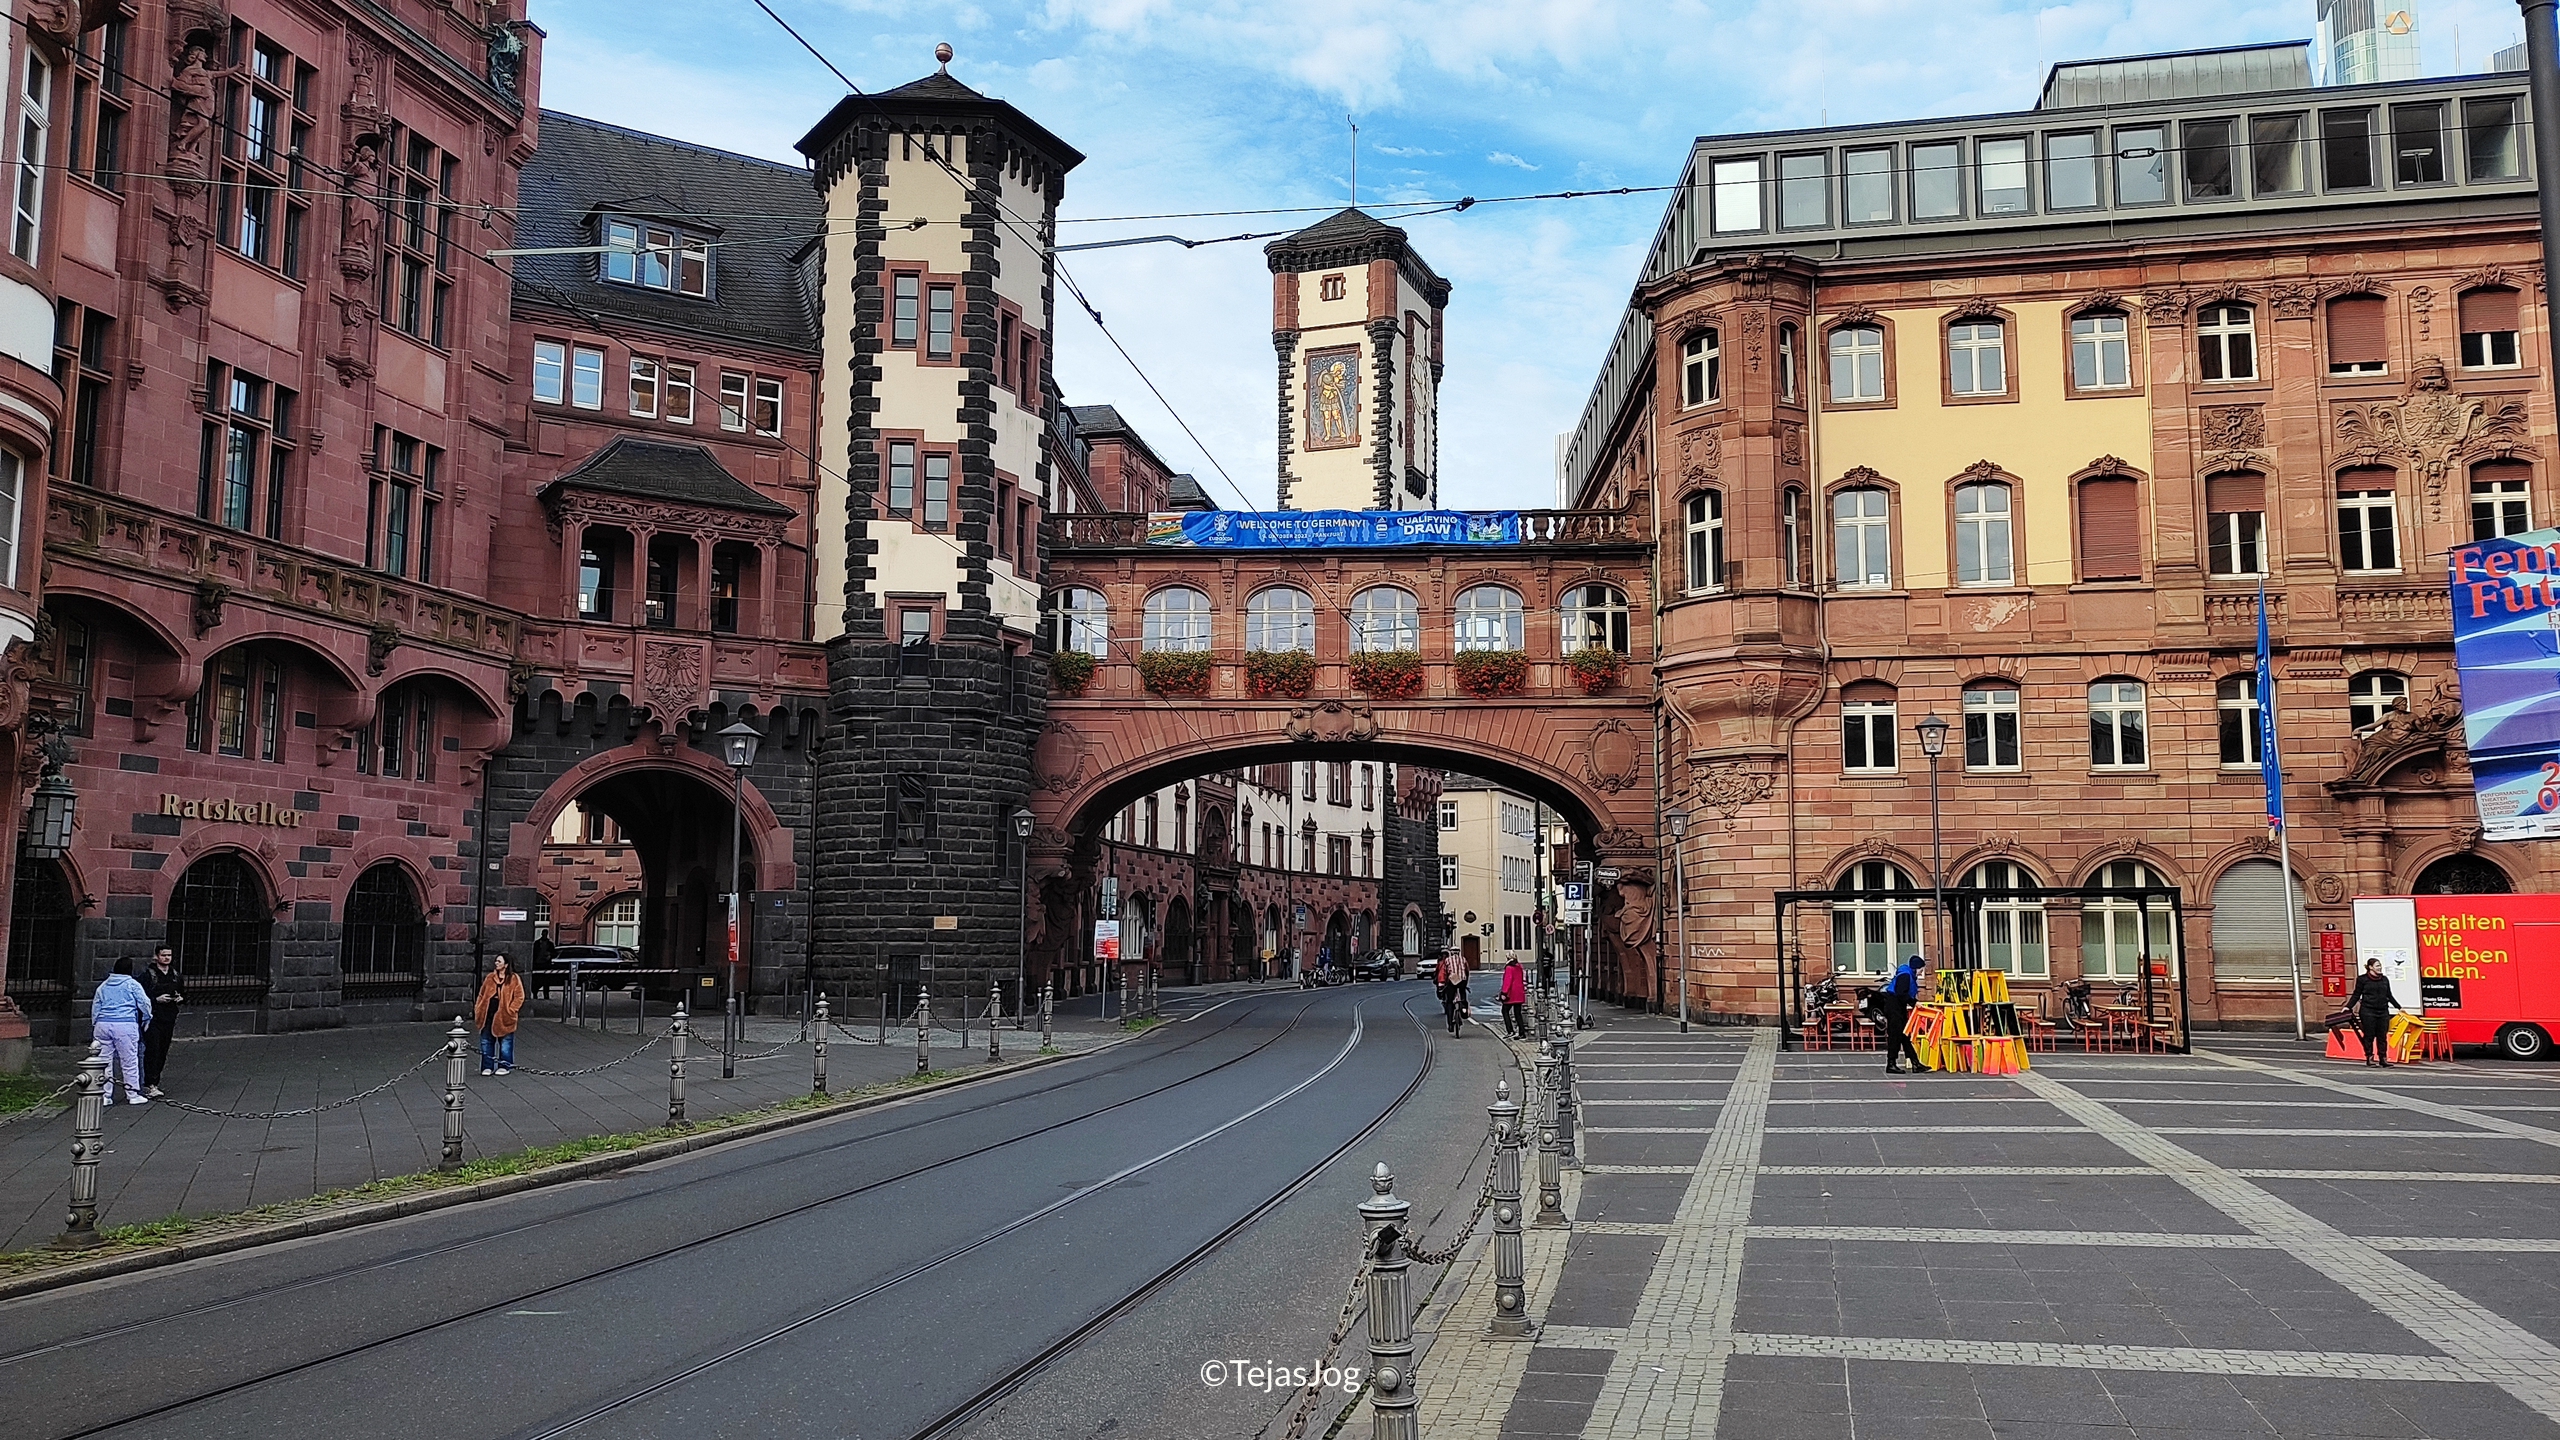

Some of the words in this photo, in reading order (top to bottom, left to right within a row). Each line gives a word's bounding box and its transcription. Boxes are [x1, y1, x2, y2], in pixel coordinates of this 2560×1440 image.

[1239, 520, 1293, 529] WELCOME
[1295, 520, 1309, 529] TO
[1311, 518, 1366, 528] GERMANY!
[1397, 515, 1458, 527] QUALIFYING
[1403, 523, 1451, 536] DRAW
[2480, 789, 2529, 798] PERFORMANCES
[160, 792, 305, 827] Ratskeller
[1568, 885, 1579, 898] P
[2422, 931, 2462, 947] wie
[2443, 946, 2508, 963] leben
[2421, 962, 2486, 980] ollen.
